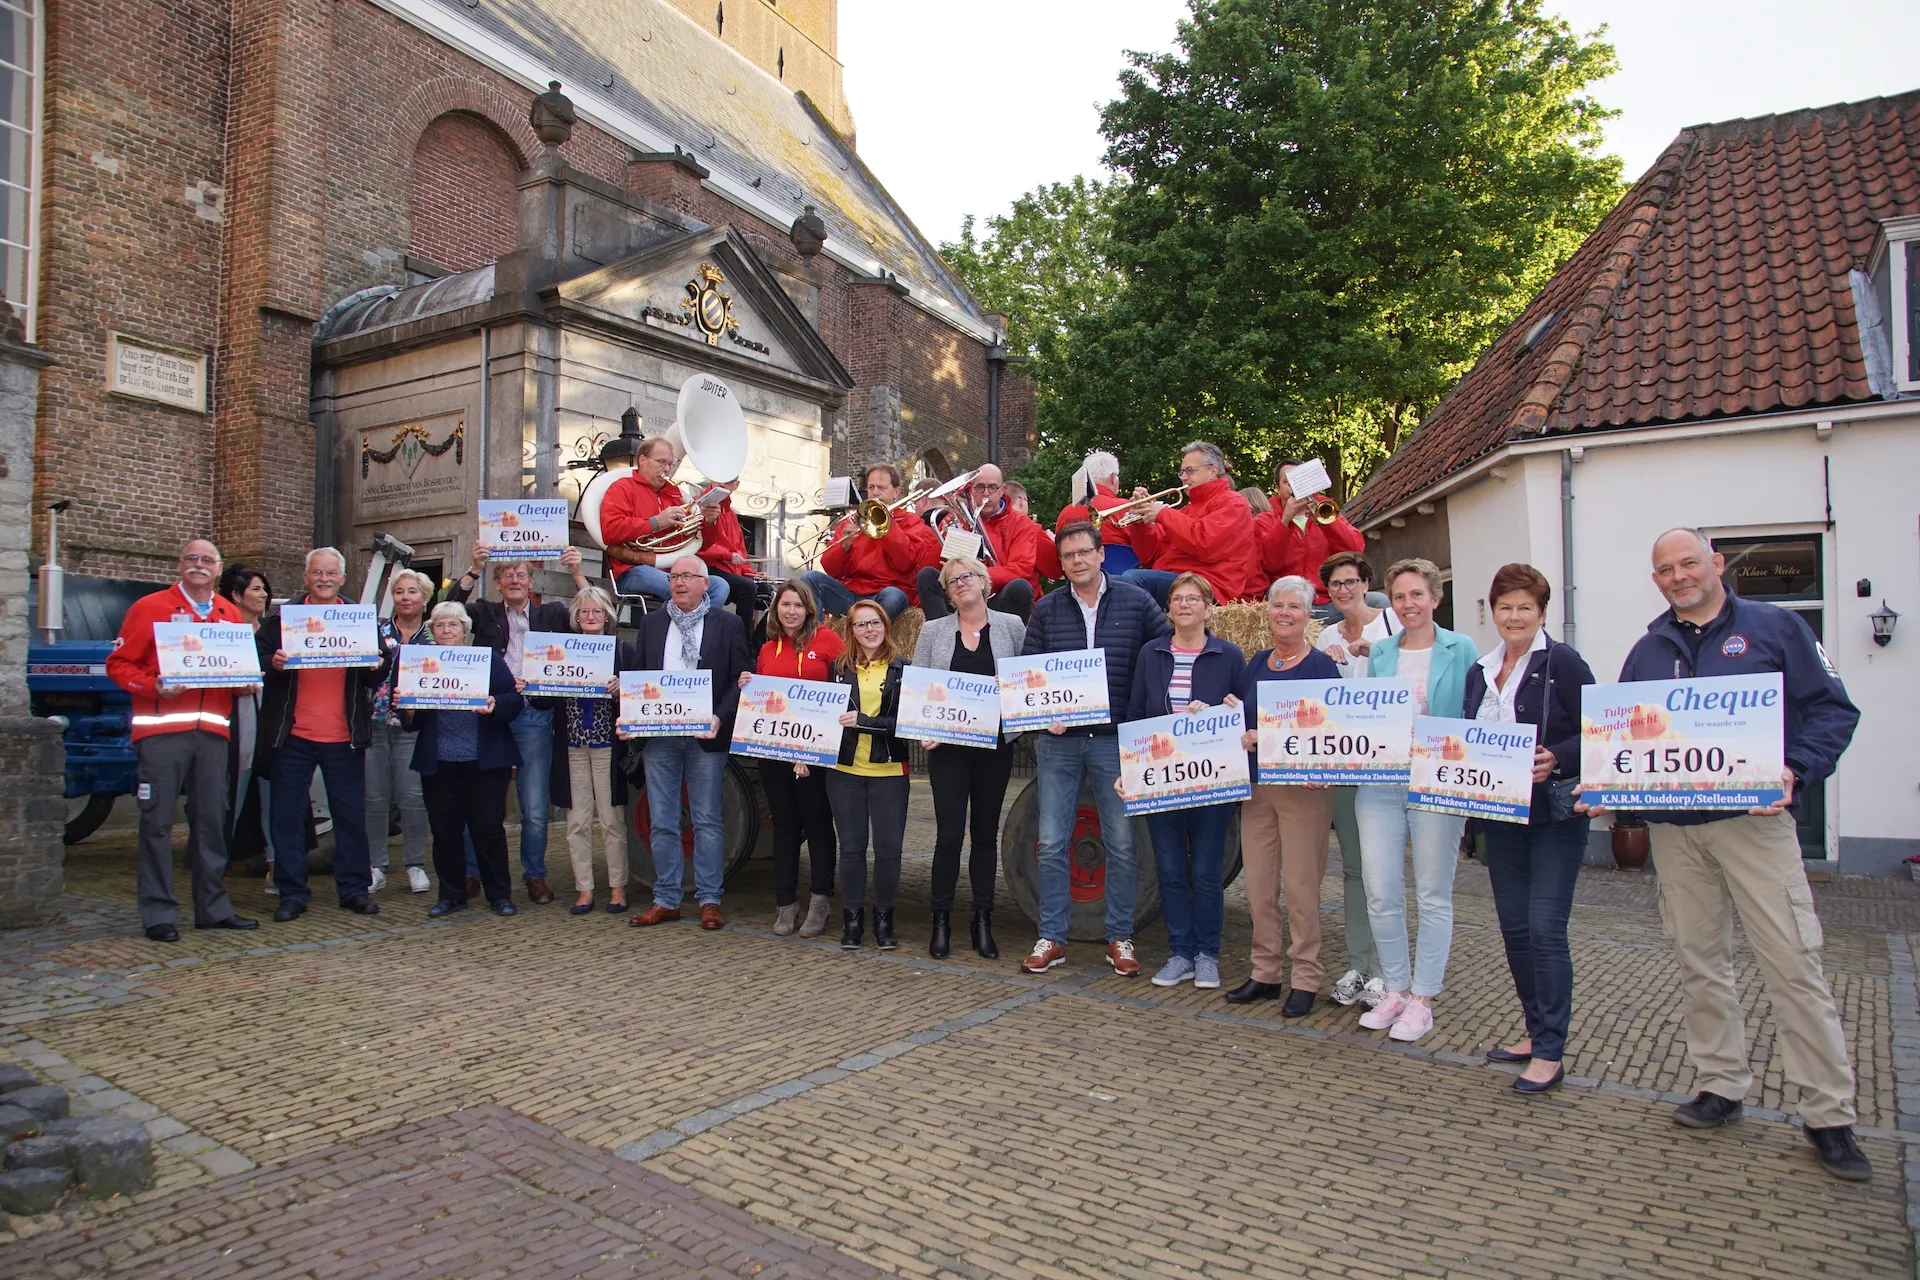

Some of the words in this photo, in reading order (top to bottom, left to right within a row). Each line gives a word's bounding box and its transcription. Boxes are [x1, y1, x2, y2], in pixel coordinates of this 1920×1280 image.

[701, 378, 727, 399] JUPITER
[518, 504, 566, 517] Cheque
[500, 530, 508, 542] €
[513, 530, 549, 543] 200,-
[1738, 565, 1768, 577] Klare
[1772, 564, 1800, 575] Water
[324, 609, 374, 622] Cheque
[200, 628, 251, 642] Cheque
[304, 637, 314, 648] €
[319, 636, 356, 648] 200,-
[565, 639, 613, 653] Cheque
[182, 656, 193, 667] €
[197, 656, 237, 668] 200,-
[440, 651, 488, 664] Cheque
[1045, 657, 1102, 672] Cheque
[544, 665, 552, 676] €
[557, 665, 593, 679] 350,-
[419, 677, 428, 688] €
[432, 677, 468, 691] 200,-
[660, 675, 710, 688] Cheque
[947, 678, 1000, 695] Cheque
[787, 684, 846, 706] Cheque
[1024, 693, 1035, 706] €
[1040, 690, 1083, 705] 350,-
[1325, 686, 1409, 710] Cheque
[1666, 687, 1778, 715] Cheque
[641, 704, 650, 715] €
[655, 703, 692, 716] 350,-
[1275, 699, 1304, 709] Tulpen
[921, 705, 932, 718] €
[936, 706, 977, 725] 350,-
[1264, 707, 1318, 723] wandeltocht
[1603, 705, 1641, 719] Tulpen
[1006, 716, 1052, 726] Muziekvereniging
[1173, 713, 1240, 736] Cheque
[1589, 713, 1658, 734] wandeltocht
[752, 718, 764, 734] €
[769, 720, 823, 743] 1500,-
[924, 729, 954, 738] Crescendo
[955, 732, 992, 742] Middelharnis
[1133, 734, 1157, 746] Tulpen
[1283, 736, 1298, 755] €
[1308, 735, 1386, 758] 1500,-
[1465, 727, 1532, 751] Cheque
[746, 746, 793, 758] Reddingsbrigade
[794, 753, 819, 762] Ouddorp
[1125, 740, 1168, 760] wandeltocht
[1613, 750, 1632, 773] €
[1644, 747, 1746, 776] 1500,-
[1143, 768, 1155, 786] €
[1162, 759, 1226, 784] 1500,-
[1261, 772, 1308, 781] Kinderafdeling
[1436, 766, 1448, 782] €
[1454, 768, 1503, 791] 350,-
[1127, 802, 1150, 810] Stichting
[1158, 797, 1191, 807] Zonnebloem
[1192, 788, 1247, 801] Goeree-Overflakkee
[1420, 795, 1433, 803] Het
[1434, 796, 1467, 808] Flakkees
[1468, 801, 1515, 814] Piratenkoor
[1601, 794, 1642, 804] K.N.R.M.
[1645, 794, 1758, 806] Ouddorp/Stellendam
